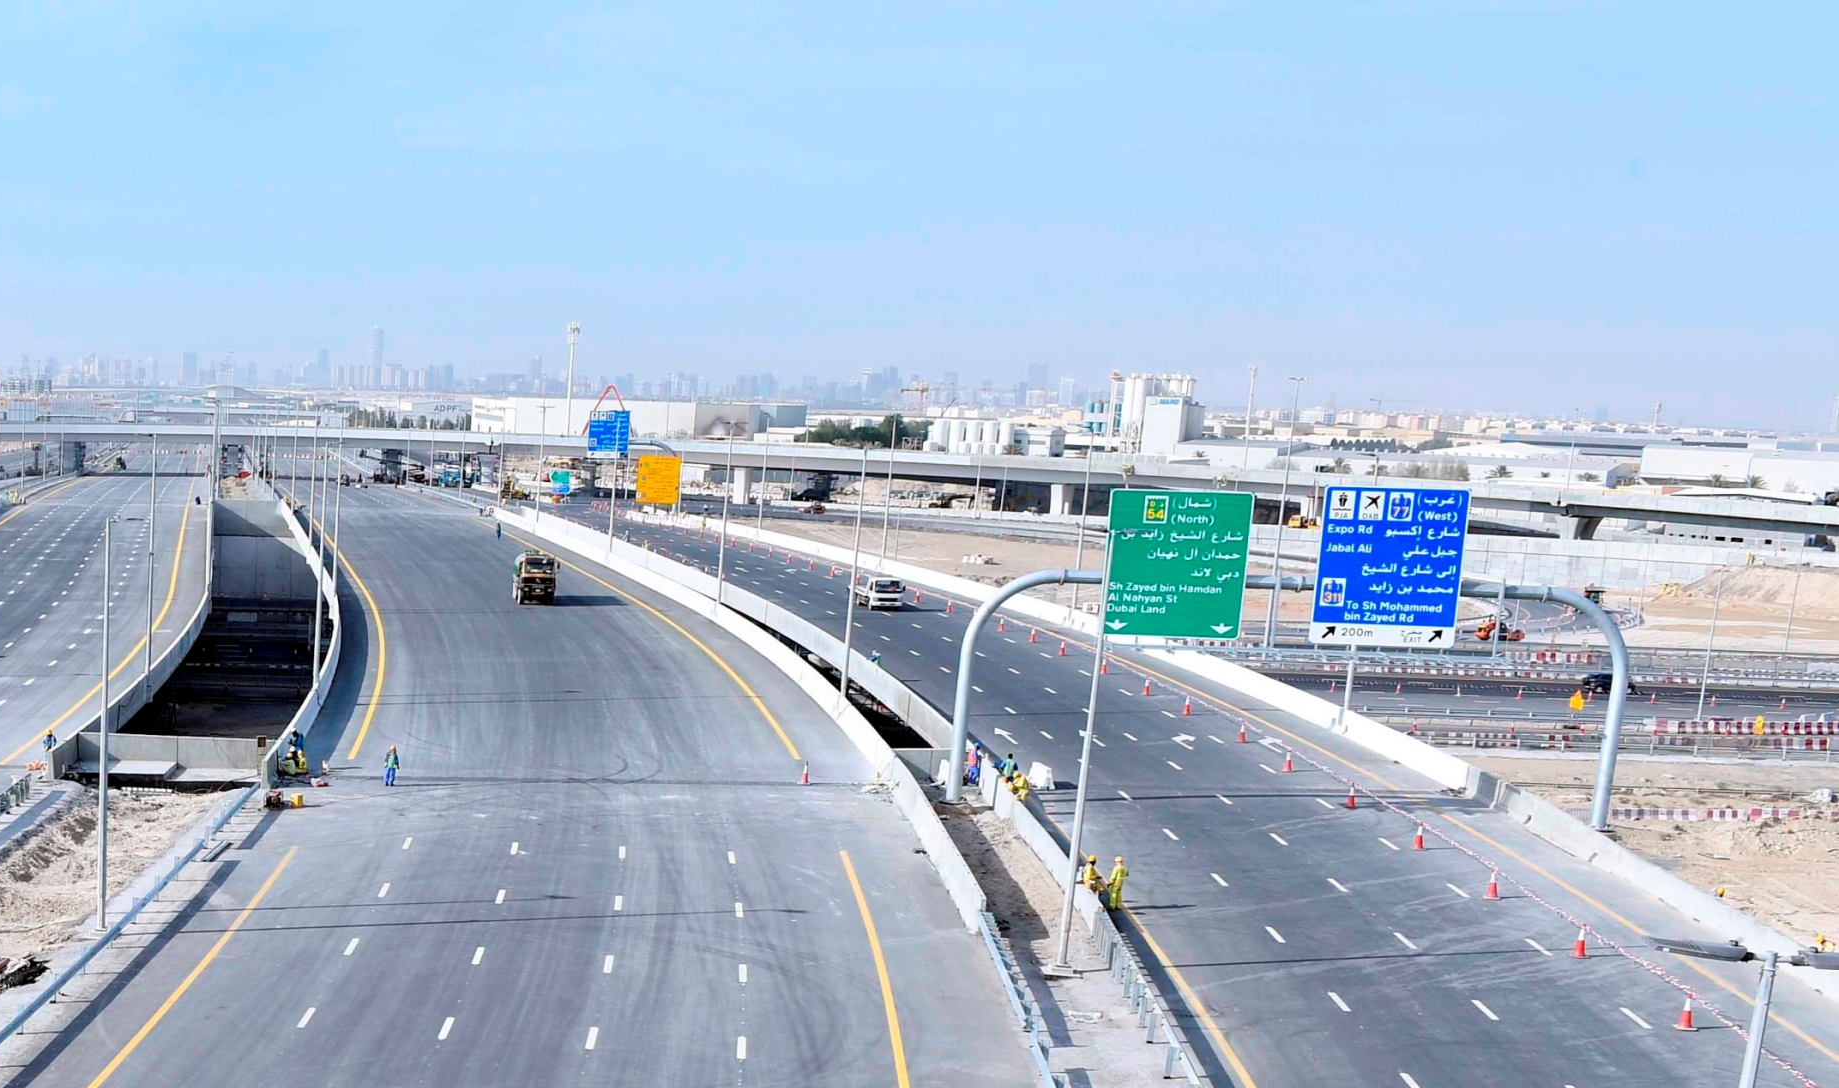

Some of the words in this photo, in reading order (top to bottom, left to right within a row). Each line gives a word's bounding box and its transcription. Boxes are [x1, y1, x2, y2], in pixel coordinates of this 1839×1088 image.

[1147, 508, 1164, 520] 54
[1393, 506, 1410, 518] 77
[1417, 511, 1458, 523] (West)
[1171, 515, 1215, 526] (North)
[1327, 524, 1354, 534] Expo
[1358, 525, 1373, 534] Rd
[1384, 525, 1422, 541] إكسبو
[1427, 526, 1460, 539] شارع
[1169, 530, 1206, 543] الشيخ
[1211, 530, 1244, 543] شارع
[1147, 548, 1179, 559] نهيان
[1201, 548, 1241, 560] حمدان
[1326, 543, 1354, 553] Jabal
[1357, 543, 1372, 553] Ali
[1402, 545, 1429, 559] علي
[1431, 545, 1457, 557] جبل
[1190, 567, 1212, 577] لاند
[1361, 563, 1397, 576] الشيخ
[1400, 564, 1433, 577] شارع
[1436, 565, 1456, 580] إلى
[1216, 571, 1240, 583] دبي
[1109, 581, 1123, 591] Sh
[1126, 582, 1157, 592] Zayed
[1159, 583, 1176, 592] bin
[1178, 584, 1222, 594] Hamdan
[1369, 581, 1393, 594] زايد
[1397, 583, 1413, 595] بن
[1417, 584, 1454, 594] محمد
[1108, 593, 1119, 602] Al
[1123, 593, 1162, 604] Nahyan
[1166, 595, 1178, 603] St
[1324, 591, 1341, 603] 311
[1107, 603, 1137, 613] Dubai
[1141, 604, 1166, 614] Land
[1346, 600, 1359, 610] To
[1362, 601, 1376, 610] Sh
[1379, 602, 1443, 613] Mohammed
[1344, 611, 1361, 621] bin
[1363, 612, 1396, 623] Zayed
[1398, 613, 1414, 623] Rd
[1341, 627, 1373, 637] 200m
